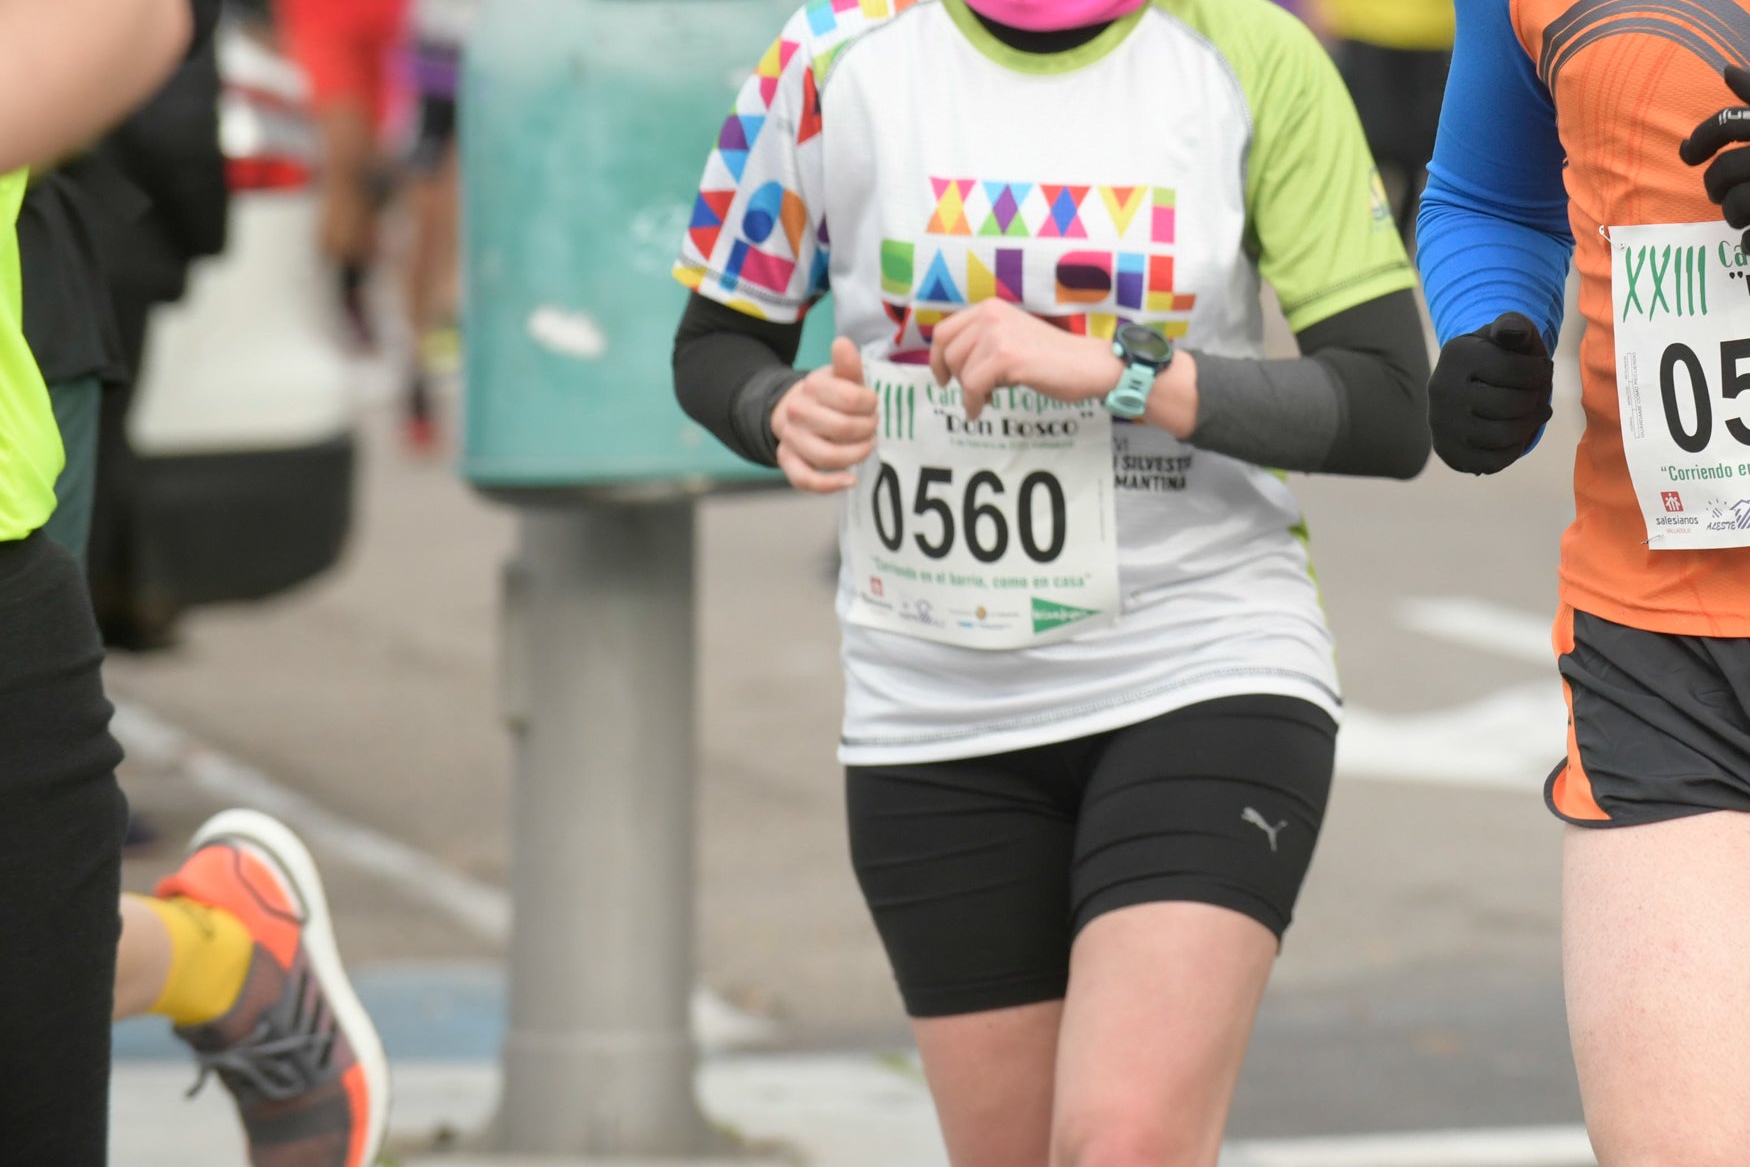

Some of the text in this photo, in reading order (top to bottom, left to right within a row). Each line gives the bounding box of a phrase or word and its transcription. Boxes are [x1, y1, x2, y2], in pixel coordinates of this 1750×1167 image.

[926, 175, 1176, 244] XXXVI
[1622, 244, 1708, 323] XXIII
[1115, 474, 1187, 492] MANTINA
[872, 462, 1067, 564] 0560
[1656, 515, 1699, 525] salesianos
[1706, 521, 1736, 531] ALESTE
